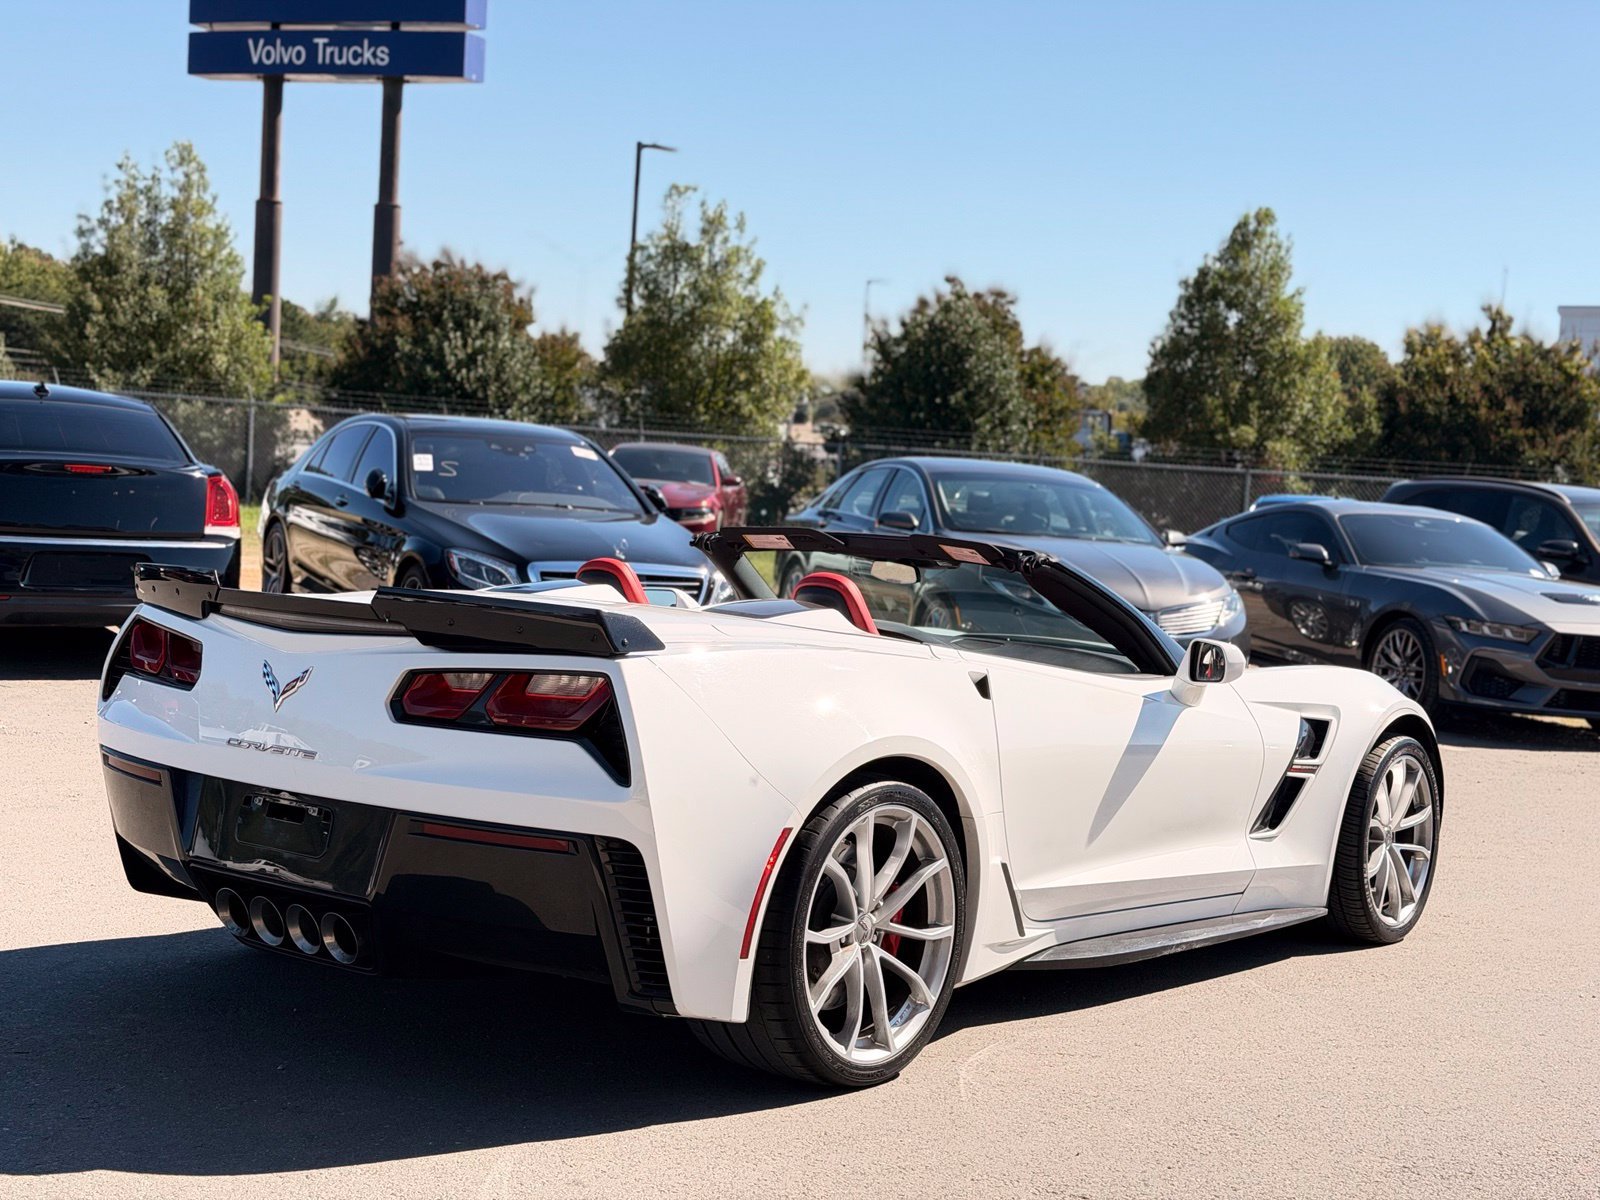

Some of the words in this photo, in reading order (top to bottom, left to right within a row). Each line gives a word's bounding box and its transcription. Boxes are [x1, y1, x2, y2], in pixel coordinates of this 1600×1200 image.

[248, 38, 306, 65] Volvo
[313, 38, 390, 66] Trucks
[227, 737, 318, 760] CORVETTE
